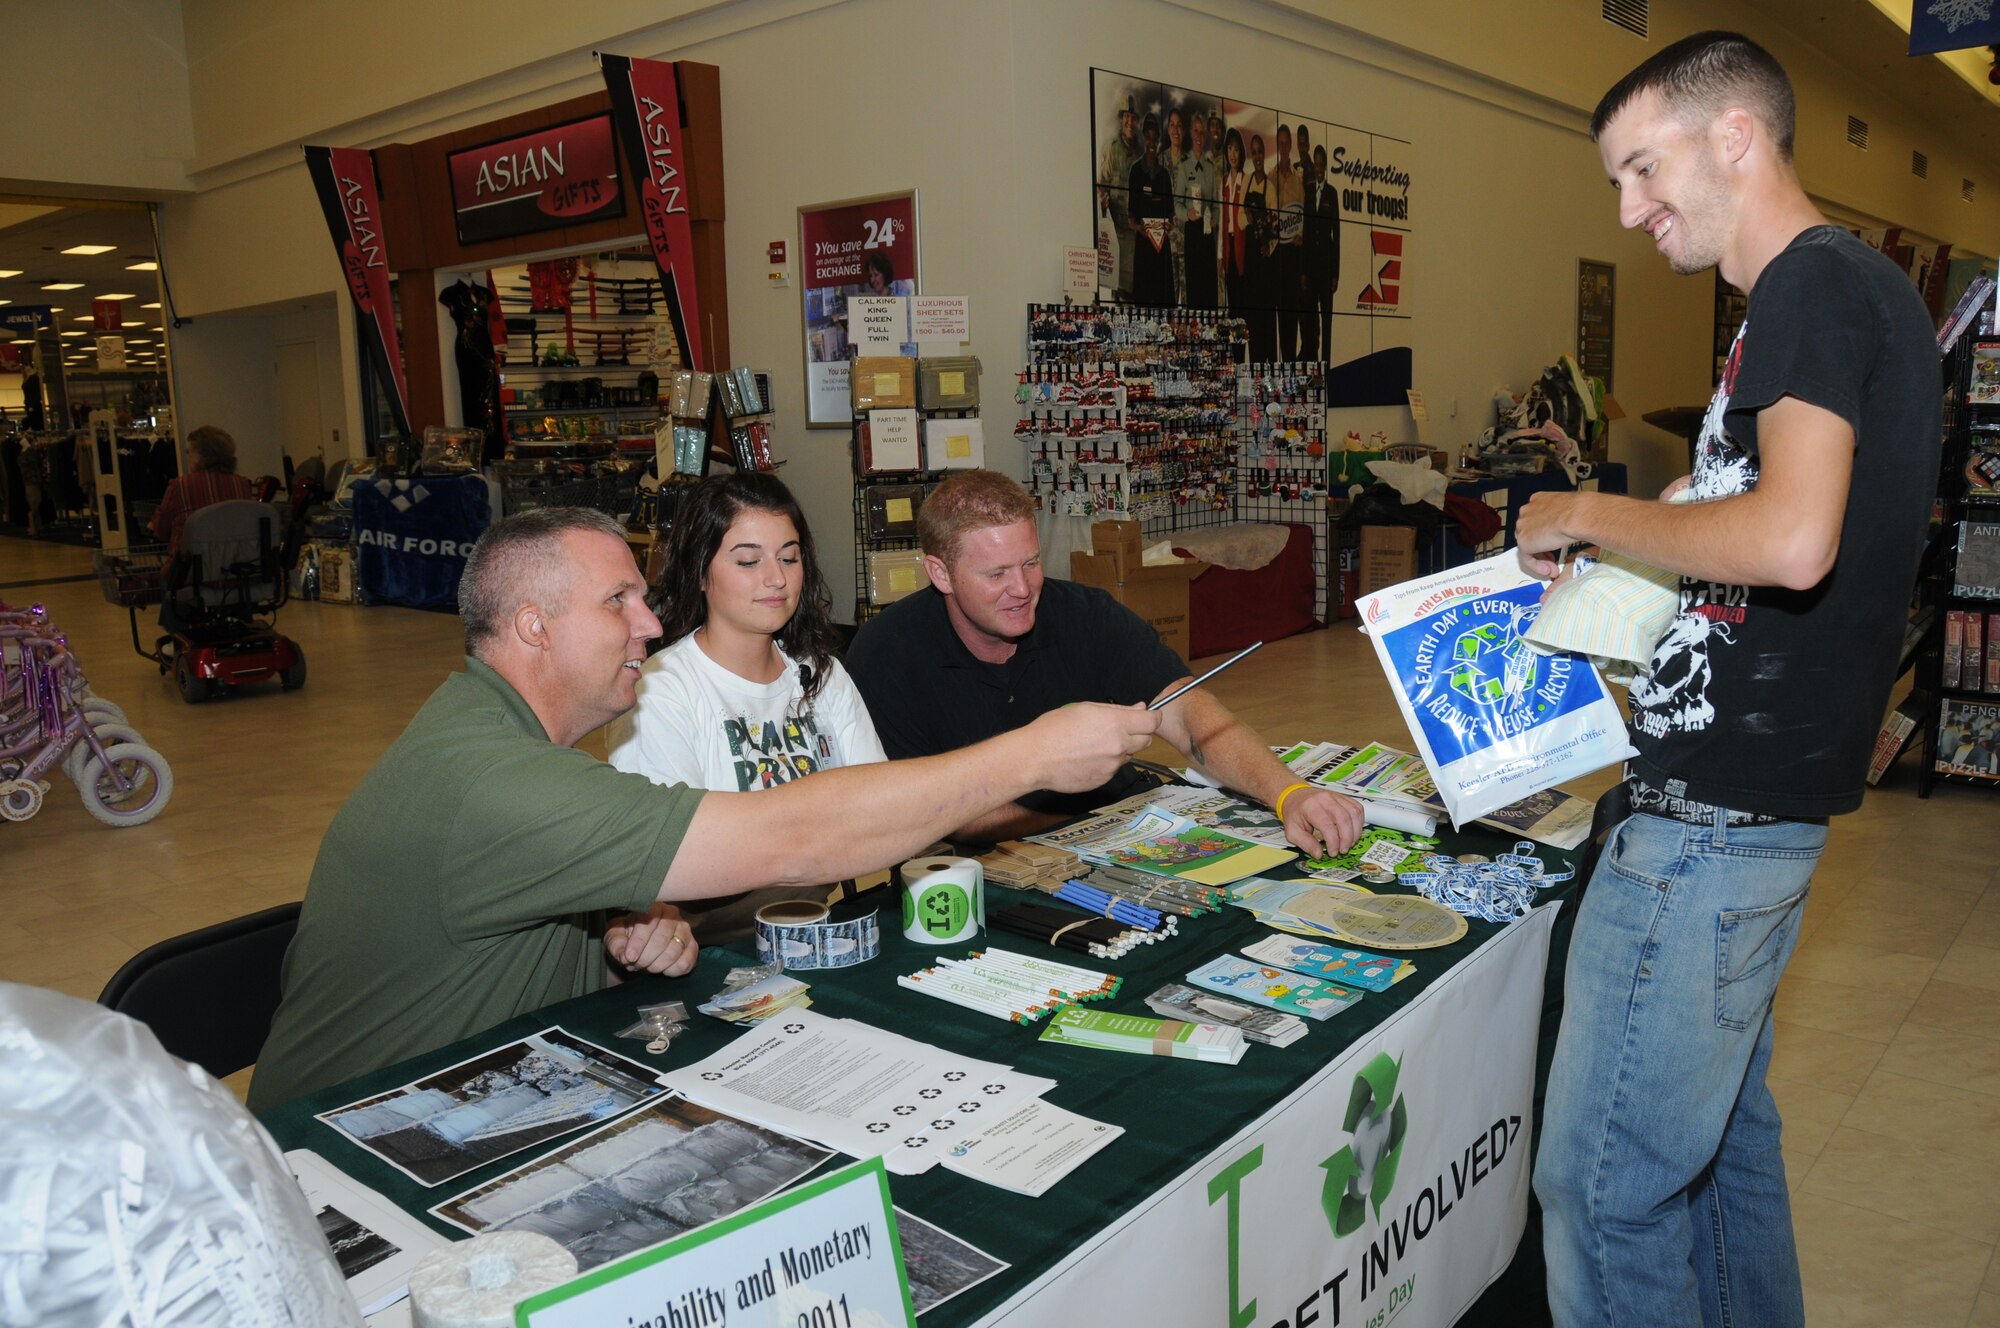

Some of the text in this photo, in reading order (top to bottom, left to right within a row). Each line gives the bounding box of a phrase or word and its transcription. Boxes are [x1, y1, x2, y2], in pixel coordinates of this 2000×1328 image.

[475, 141, 564, 196] ASIAN
[640, 96, 687, 215] ASIAN
[1331, 146, 1410, 195] Supporting
[552, 178, 601, 211] GIFTS
[1343, 188, 1408, 221] our troops!
[341, 177, 384, 268] ASIAN
[645, 197, 669, 255] GIFTS
[821, 217, 905, 255] You save 24%
[816, 264, 862, 279] EXCHANGE
[1068, 251, 1096, 259] CHRISTMAS
[6, 315, 42, 323] JEWELY
[359, 529, 476, 558] AIR FORC
[1973, 526, 2000, 536] ANTI
[1394, 592, 1406, 600] Tips
[1406, 588, 1419, 597] from
[1419, 583, 1434, 593] Keep
[1434, 577, 1456, 588] America
[1432, 594, 1443, 605] IS
[1442, 589, 1454, 599] IN
[1456, 586, 1479, 595] OUR
[1957, 585, 2000, 598] PUZZL
[1415, 638, 1440, 685] EARTH
[1432, 609, 1460, 636] DAY
[1428, 693, 1480, 737] REDUCE
[1536, 655, 1572, 706] RECYCL
[734, 753, 818, 792] PRID
[1458, 773, 1491, 791] Keesler
[1581, 727, 1607, 742] Office
[1938, 760, 1988, 777] PUZZLE
[1500, 771, 1525, 785] Phone:
[1047, 817, 1123, 843] RECYCLING
[735, 1258, 777, 1311] and
[779, 1221, 872, 1290] Monetary
[798, 1293, 852, 1328] 2011
[1388, 1273, 1417, 1316] Day
